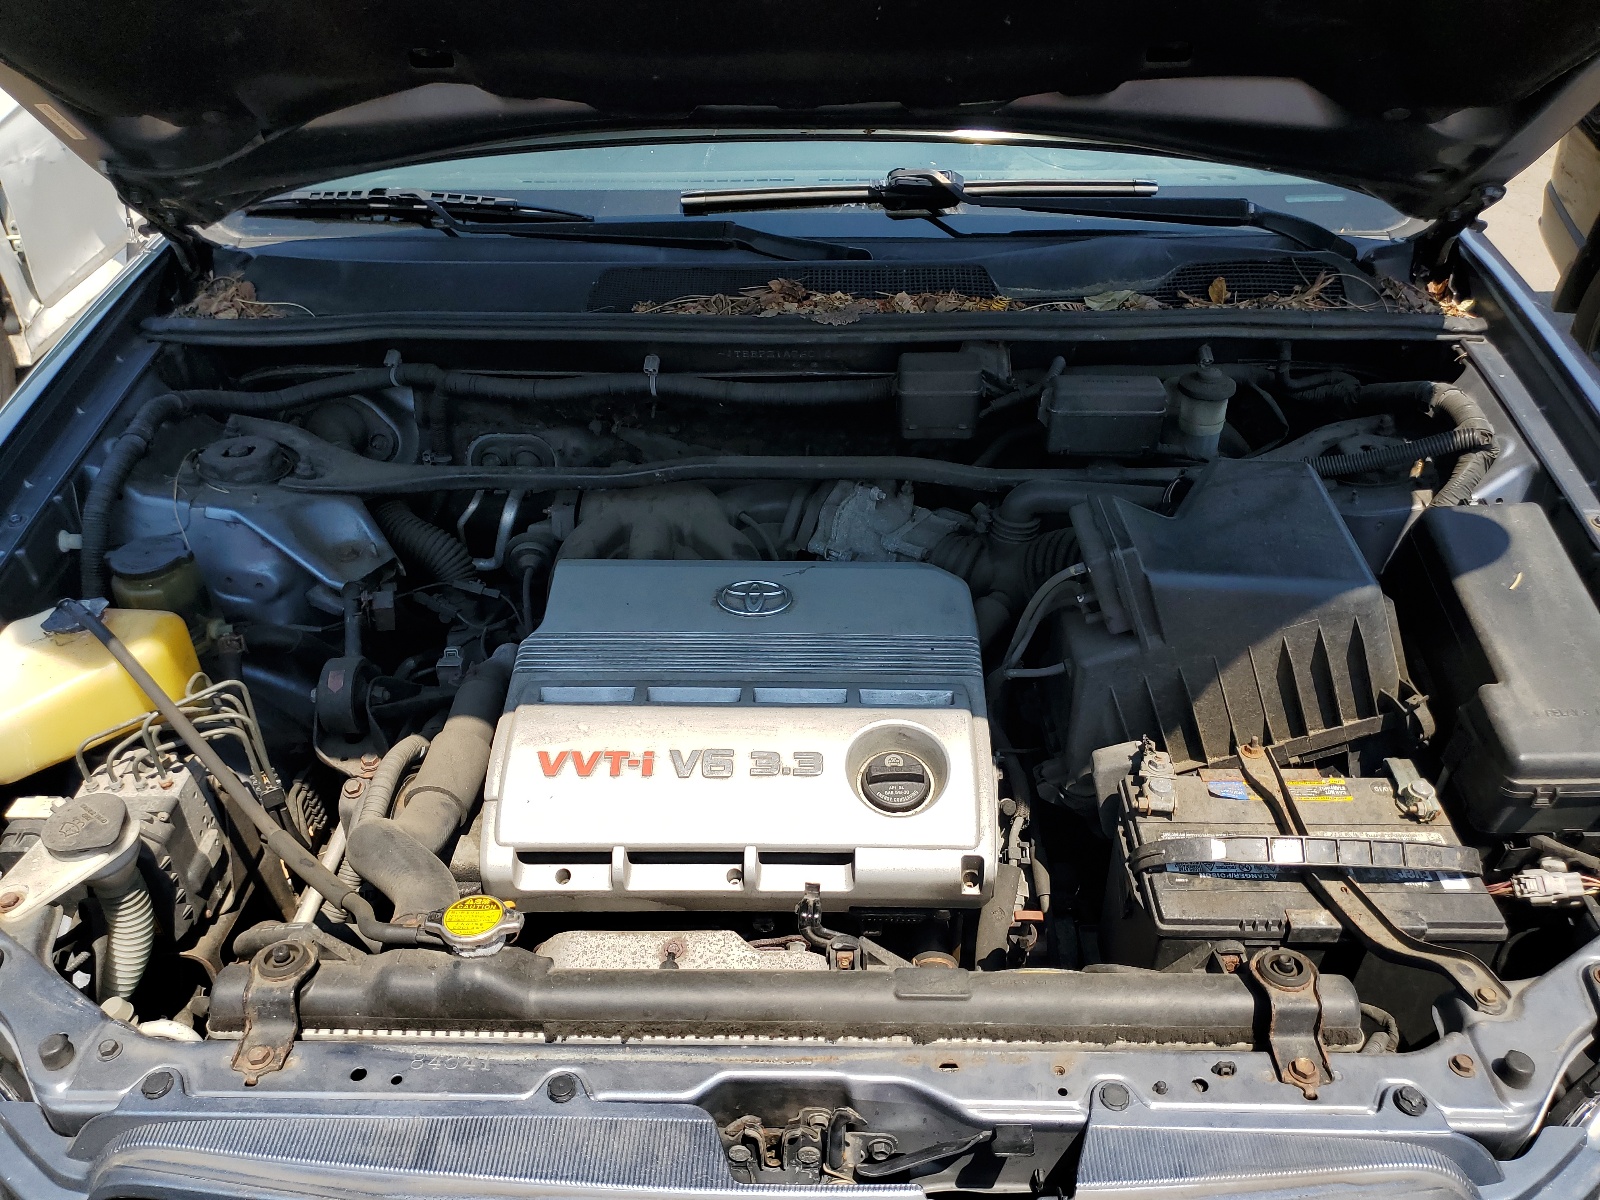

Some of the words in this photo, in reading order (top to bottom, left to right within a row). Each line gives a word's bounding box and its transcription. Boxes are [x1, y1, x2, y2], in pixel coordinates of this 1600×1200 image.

[537, 749, 654, 778] VVT-i
[669, 748, 735, 779] V6
[749, 748, 824, 778] 3.3
